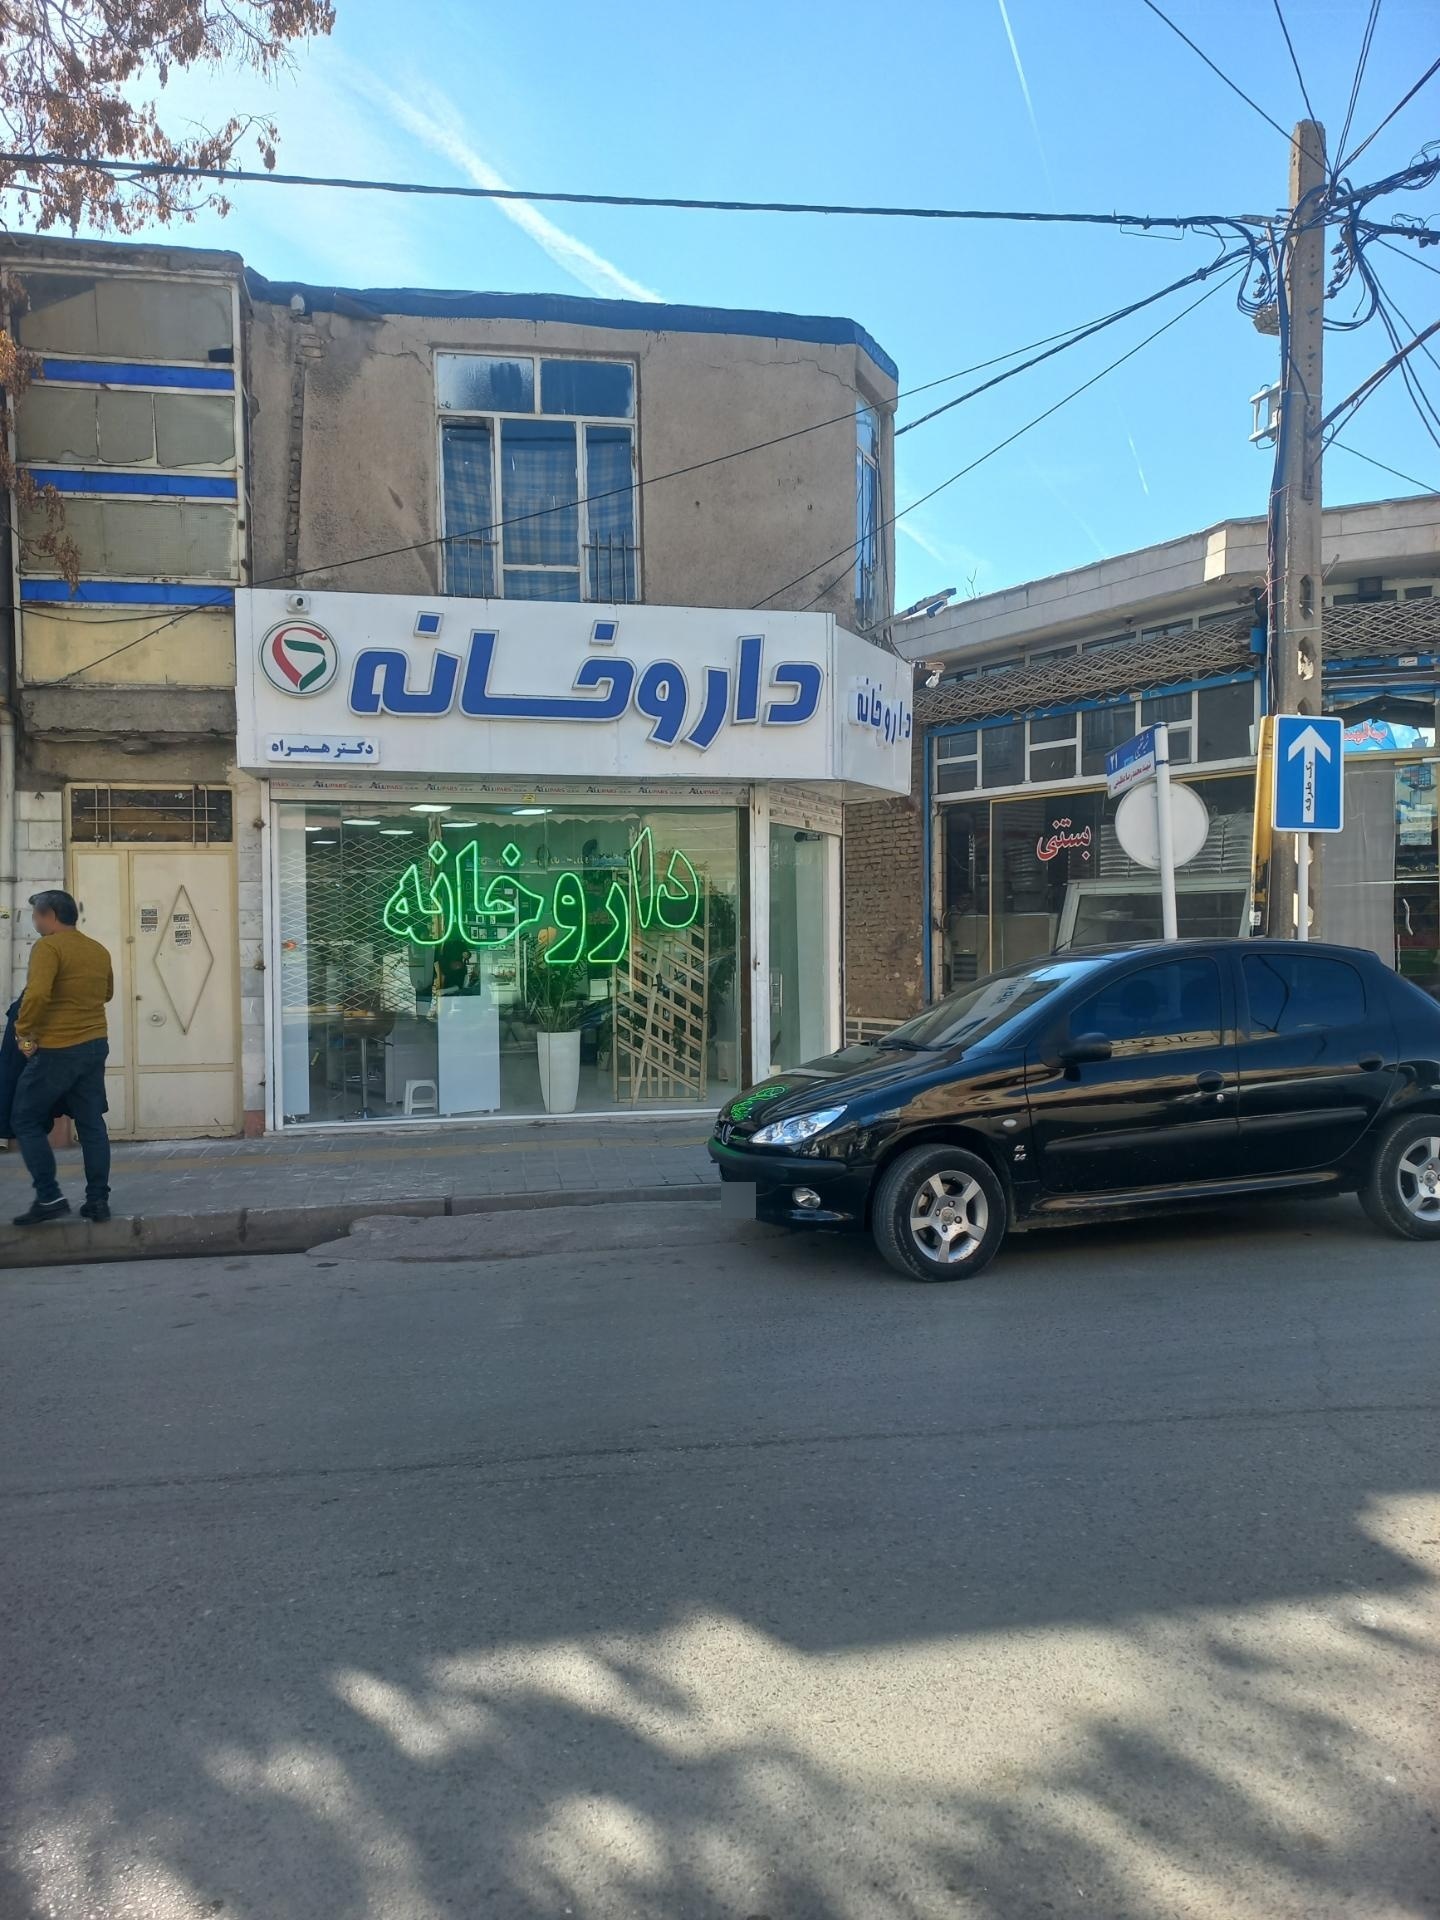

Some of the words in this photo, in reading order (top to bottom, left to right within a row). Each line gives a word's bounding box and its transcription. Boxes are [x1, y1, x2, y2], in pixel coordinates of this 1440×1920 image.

[348, 609, 824, 752] داروخانه
[857, 678, 912, 745] داروخانه
[271, 738, 331, 757] همراه
[334, 741, 374, 758] دکتر
[1305, 760, 1315, 778] یک
[1304, 781, 1314, 812] طرفه
[1036, 817, 1092, 861] بستنی
[382, 826, 701, 966] داروخانه
